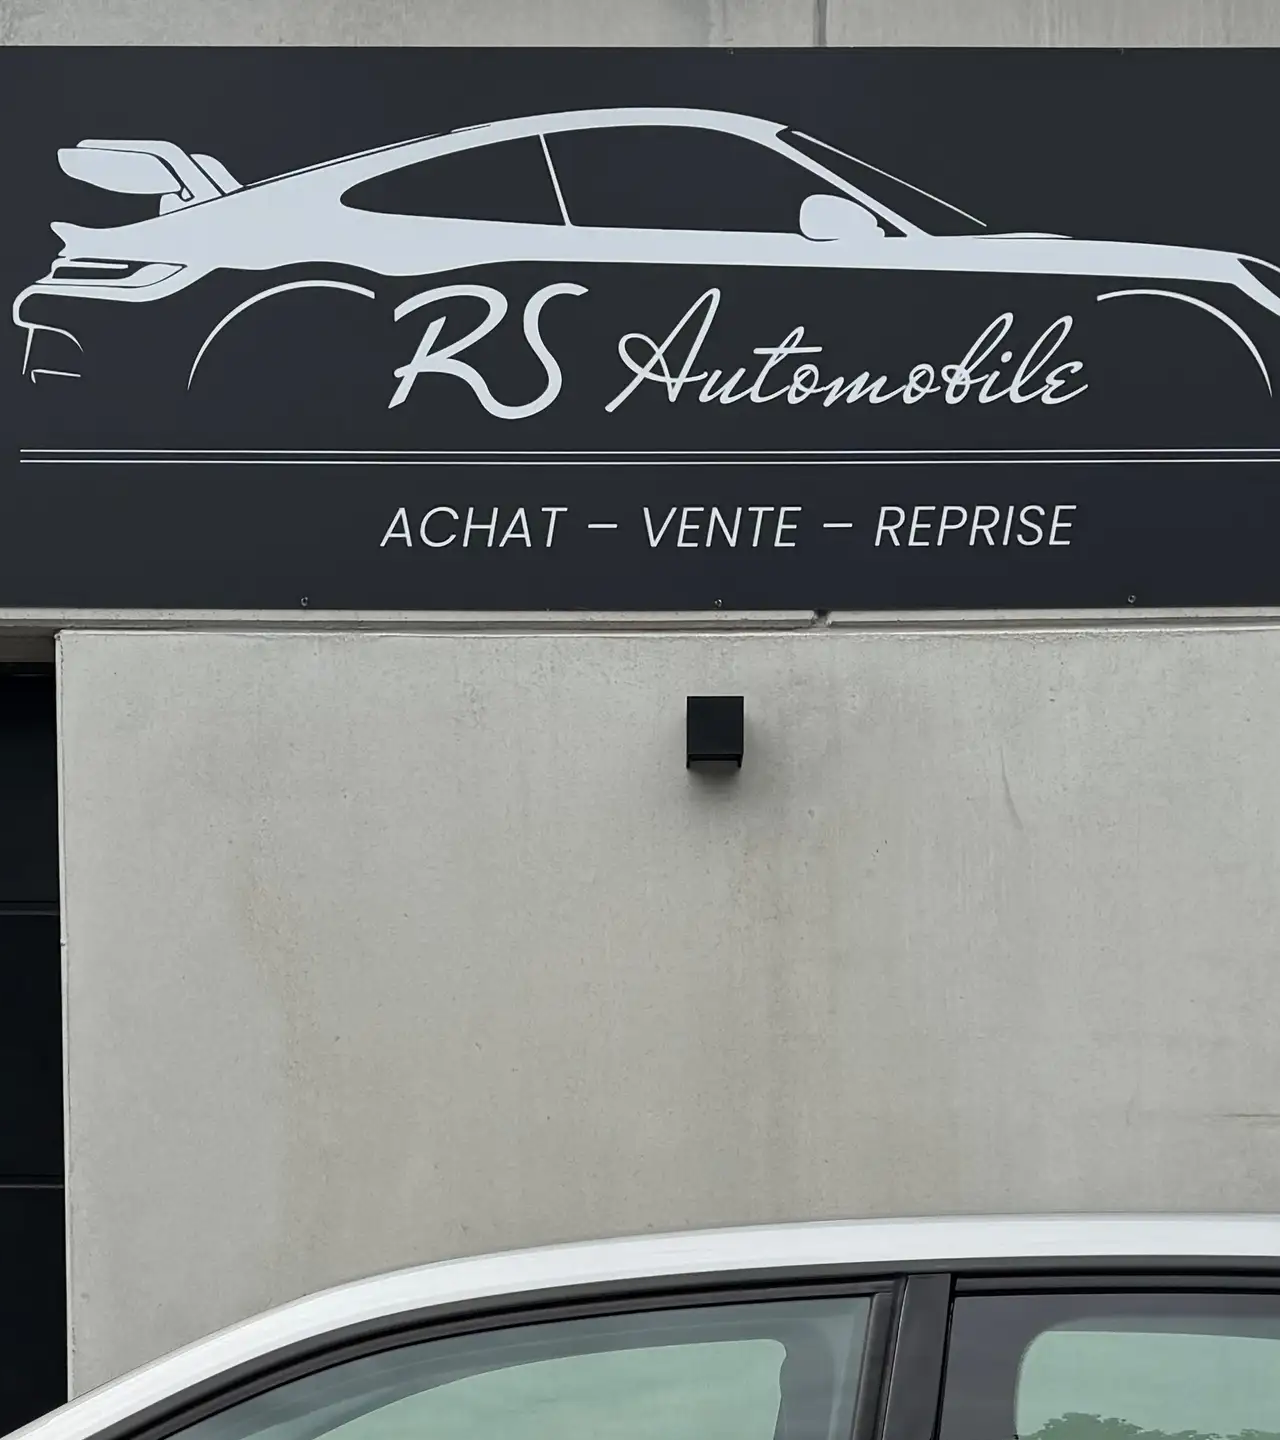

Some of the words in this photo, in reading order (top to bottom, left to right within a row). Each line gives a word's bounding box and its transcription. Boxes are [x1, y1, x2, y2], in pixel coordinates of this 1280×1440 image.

[387, 282, 589, 420] RS
[604, 287, 1089, 413] Automobile
[379, 506, 568, 548] ACHAT
[643, 506, 802, 548] VENTE
[874, 504, 1077, 547] REPRISE
